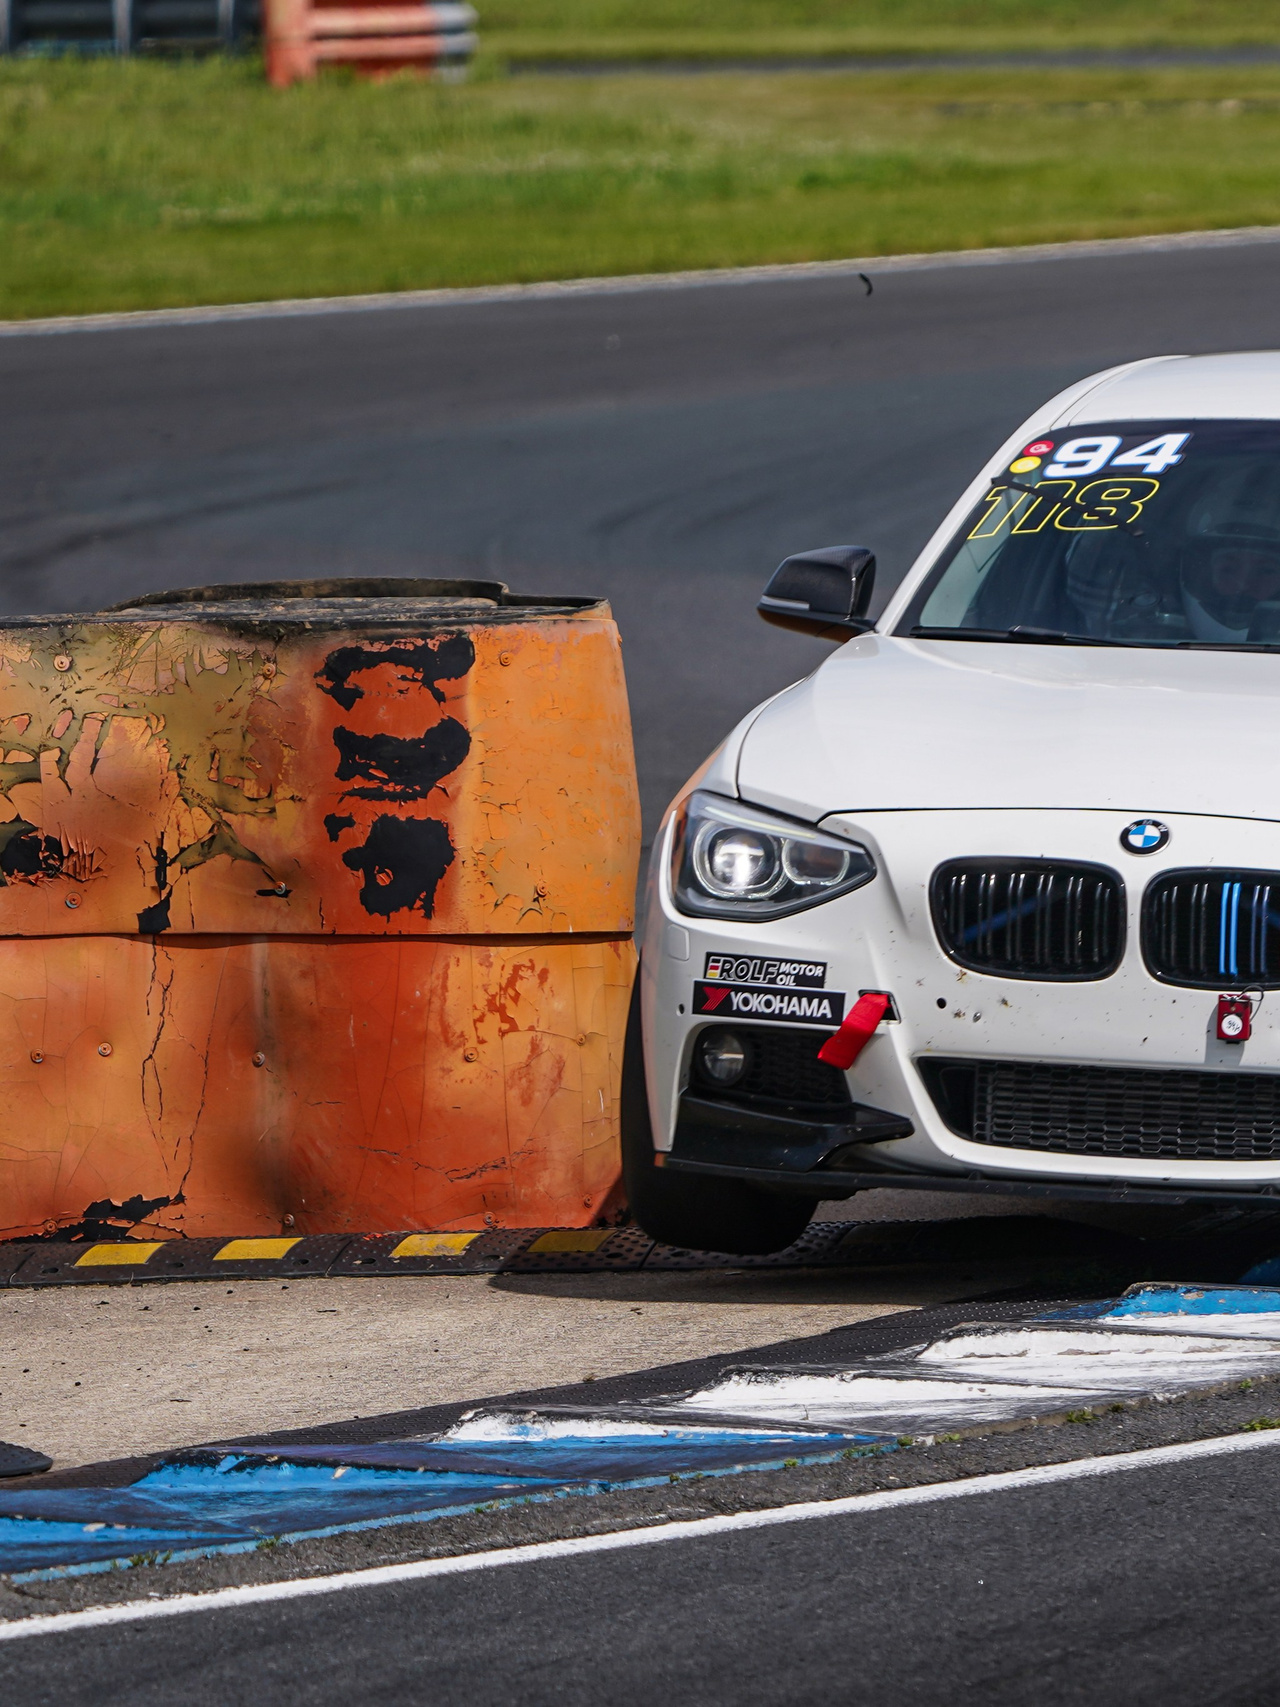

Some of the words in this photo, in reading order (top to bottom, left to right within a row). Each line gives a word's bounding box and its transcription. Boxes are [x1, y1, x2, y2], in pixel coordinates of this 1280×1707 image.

[1042, 432, 1191, 478] 94
[967, 477, 1160, 540] 118
[719, 958, 781, 984] ROLF
[779, 962, 824, 977] MOTOR
[776, 974, 796, 986] OIL
[730, 991, 832, 1019] YOKOHAMA
